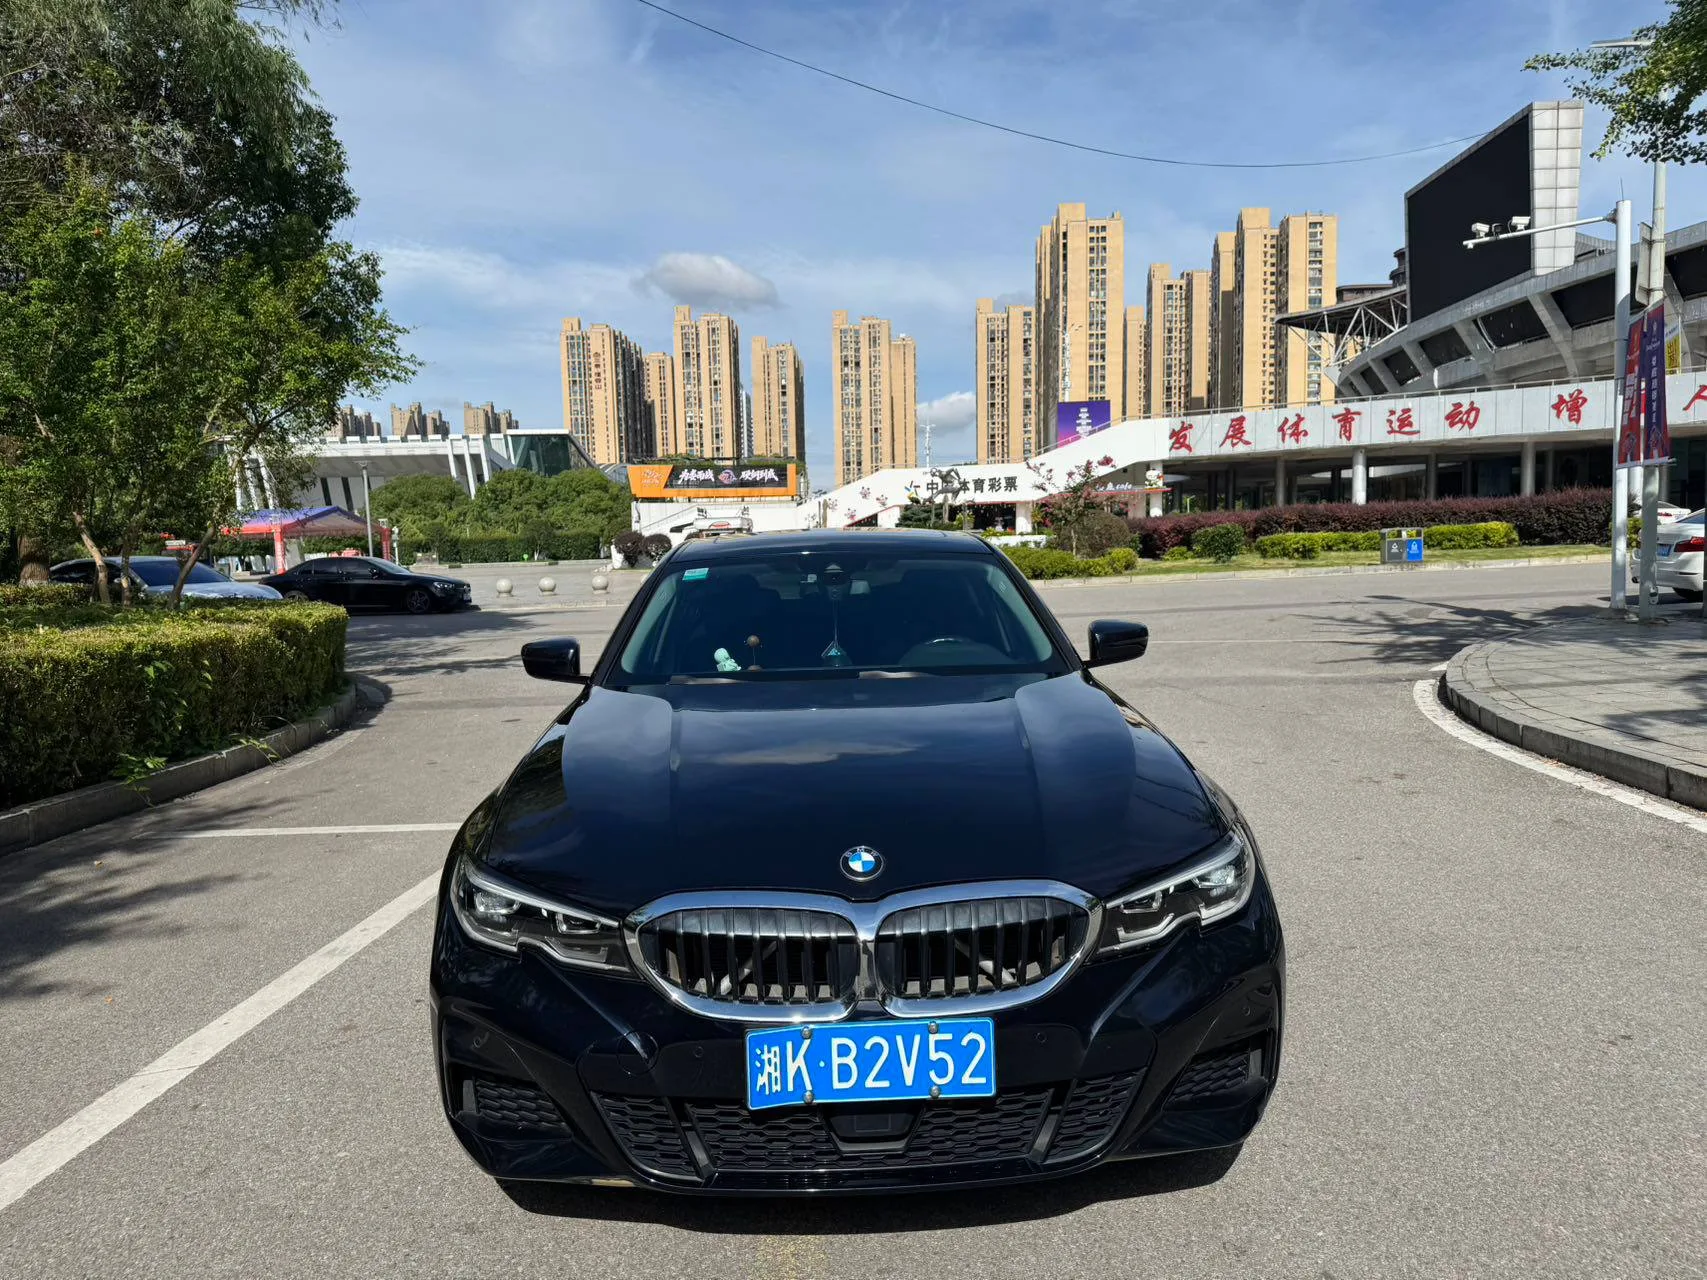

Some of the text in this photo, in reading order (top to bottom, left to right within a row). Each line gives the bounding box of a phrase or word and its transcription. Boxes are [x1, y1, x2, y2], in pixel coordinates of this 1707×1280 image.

[1168, 400, 1481, 453] 发展体育运动
[926, 476, 1018, 497] 中体育彩票
